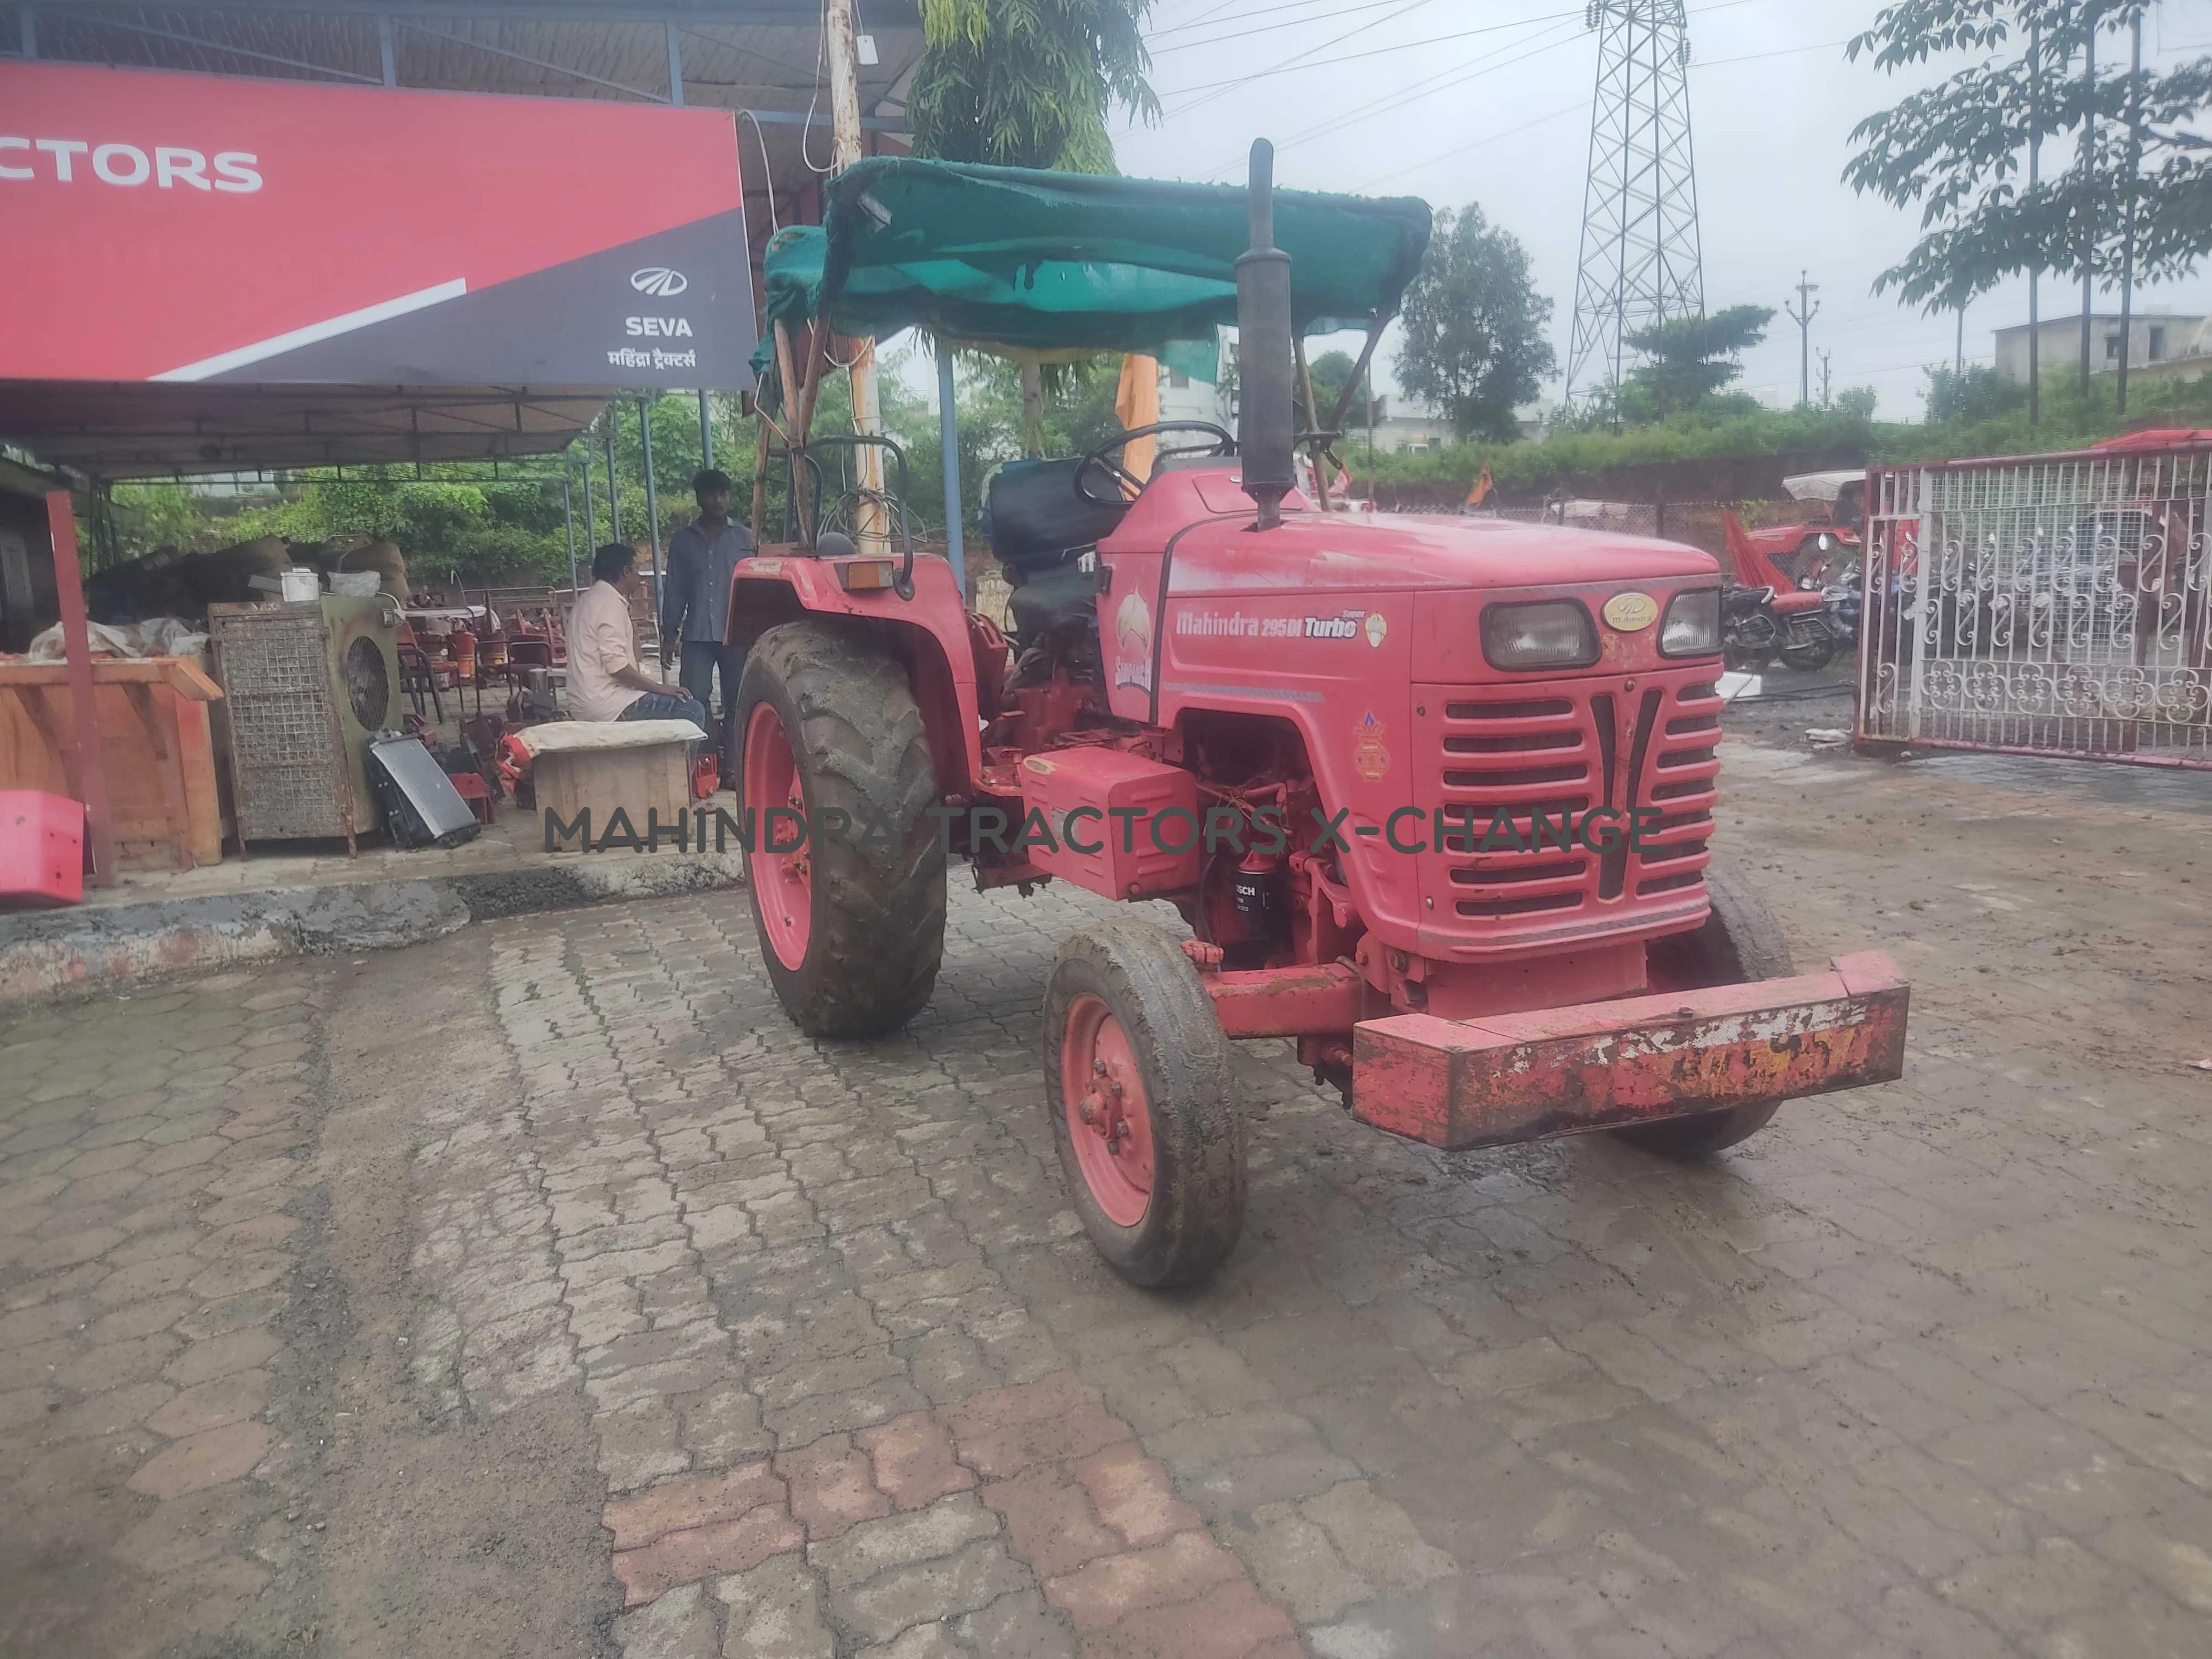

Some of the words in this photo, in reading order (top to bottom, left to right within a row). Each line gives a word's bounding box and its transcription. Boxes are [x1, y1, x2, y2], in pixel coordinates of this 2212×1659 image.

[625, 316, 693, 337] SEVA
[1176, 611, 1259, 637] Mahindra
[1305, 617, 1358, 638] Turbo
